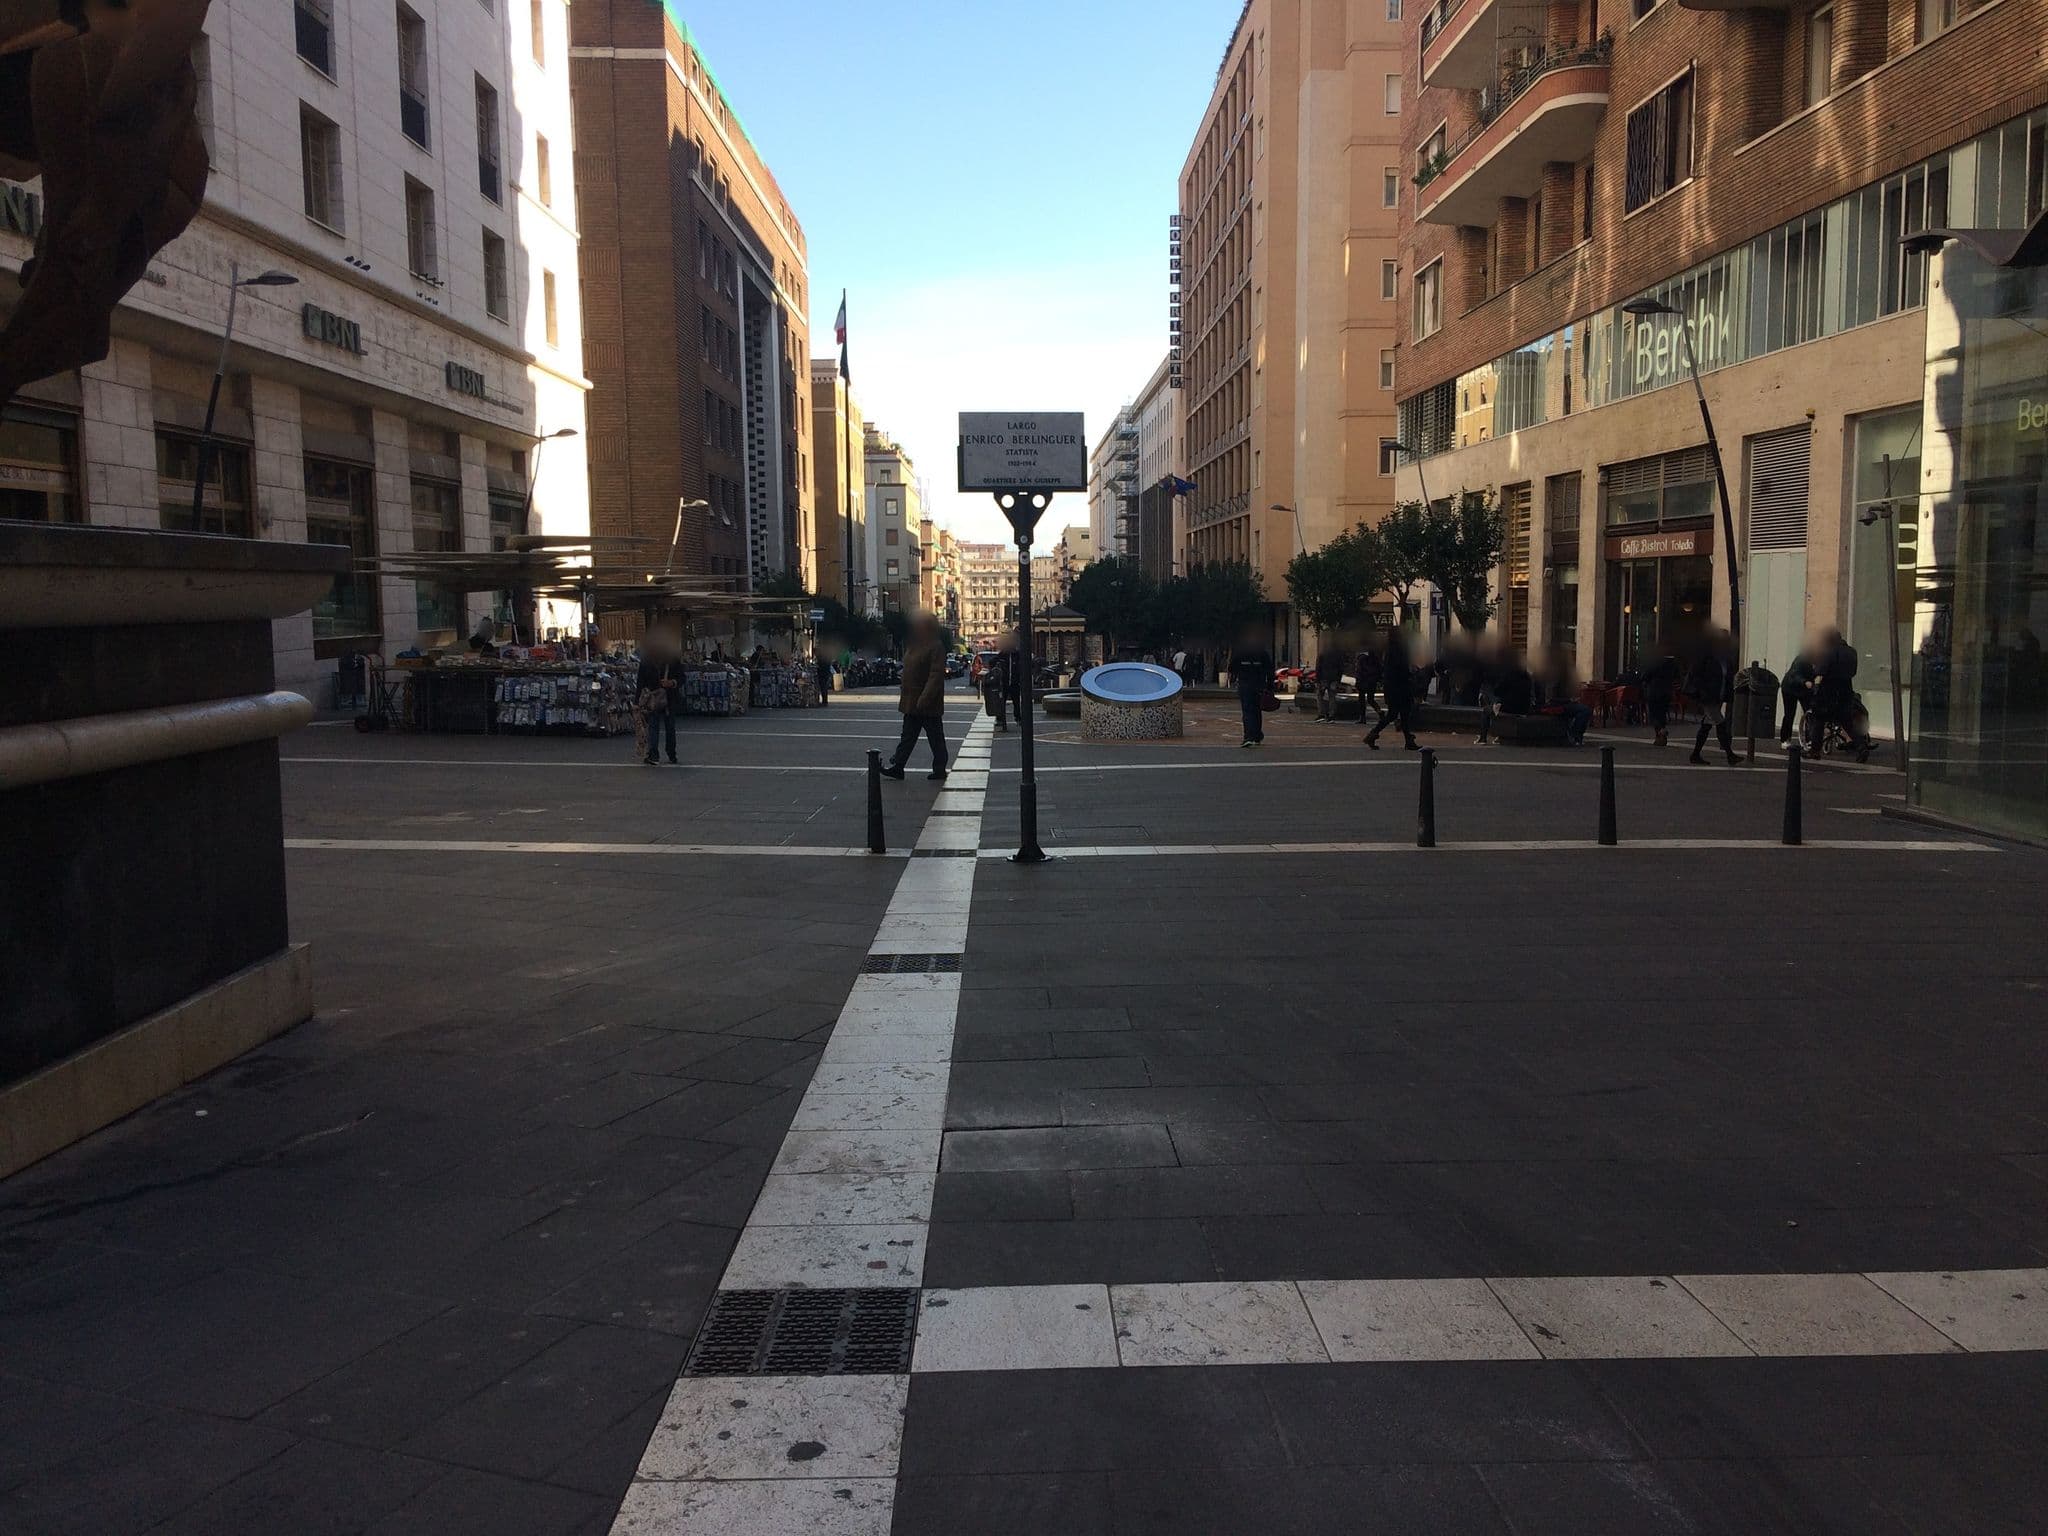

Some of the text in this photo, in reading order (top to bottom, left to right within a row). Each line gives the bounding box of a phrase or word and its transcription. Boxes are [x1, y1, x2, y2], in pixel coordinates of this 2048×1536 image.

[1170, 215, 1182, 389] HOTEL ORIENTE
[320, 309, 368, 356] BNL
[1007, 421, 1037, 431] LARGO
[965, 434, 1077, 445] ENRICO BERLINGUER
[1005, 448, 1039, 456] STATISTA
